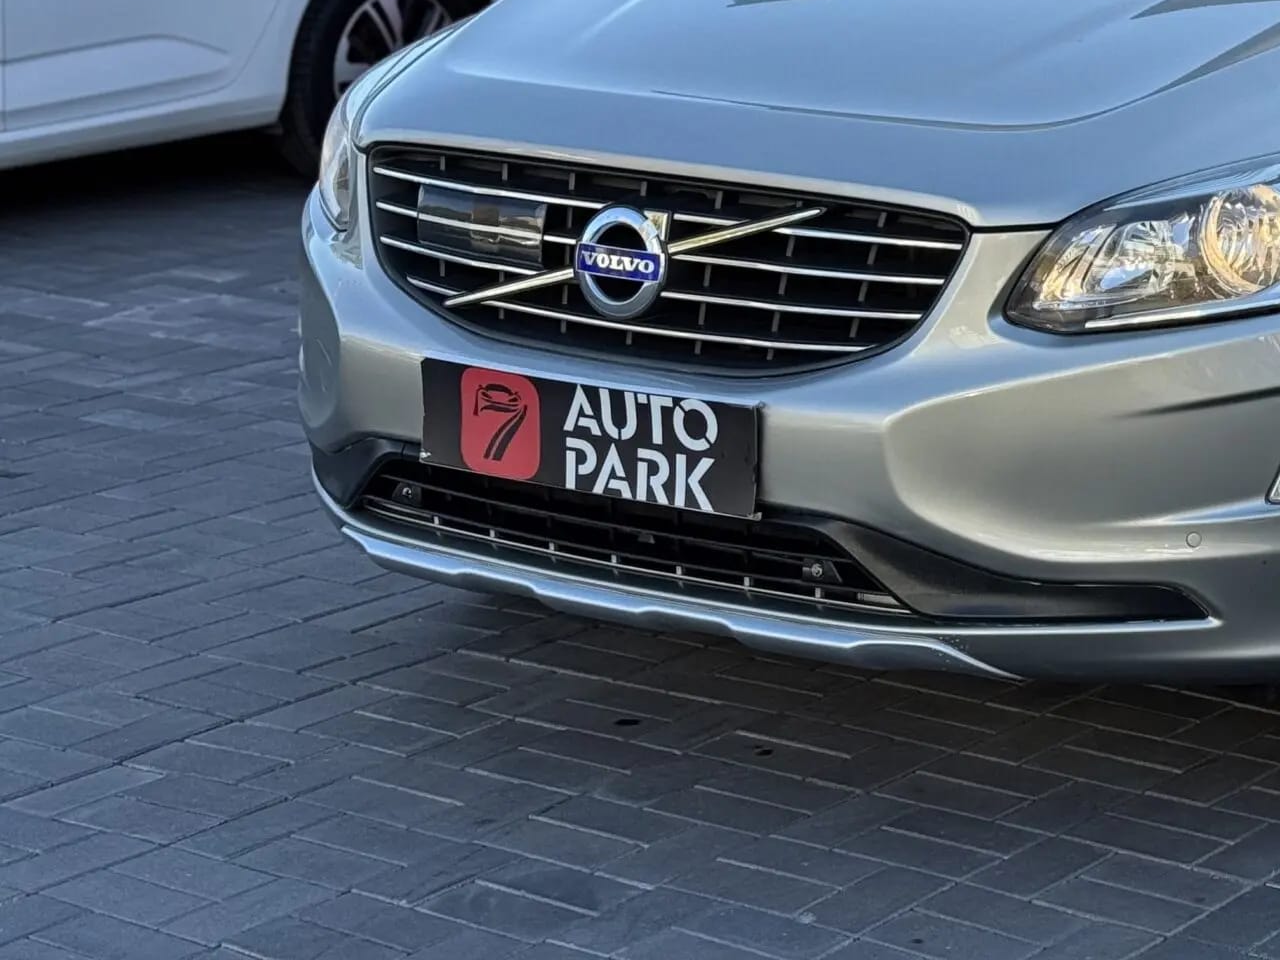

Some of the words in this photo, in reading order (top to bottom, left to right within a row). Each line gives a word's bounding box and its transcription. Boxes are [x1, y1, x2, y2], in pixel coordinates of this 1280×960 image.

[580, 251, 656, 275] VOLVO
[563, 384, 718, 451] AUTO
[564, 437, 715, 512] PARK
